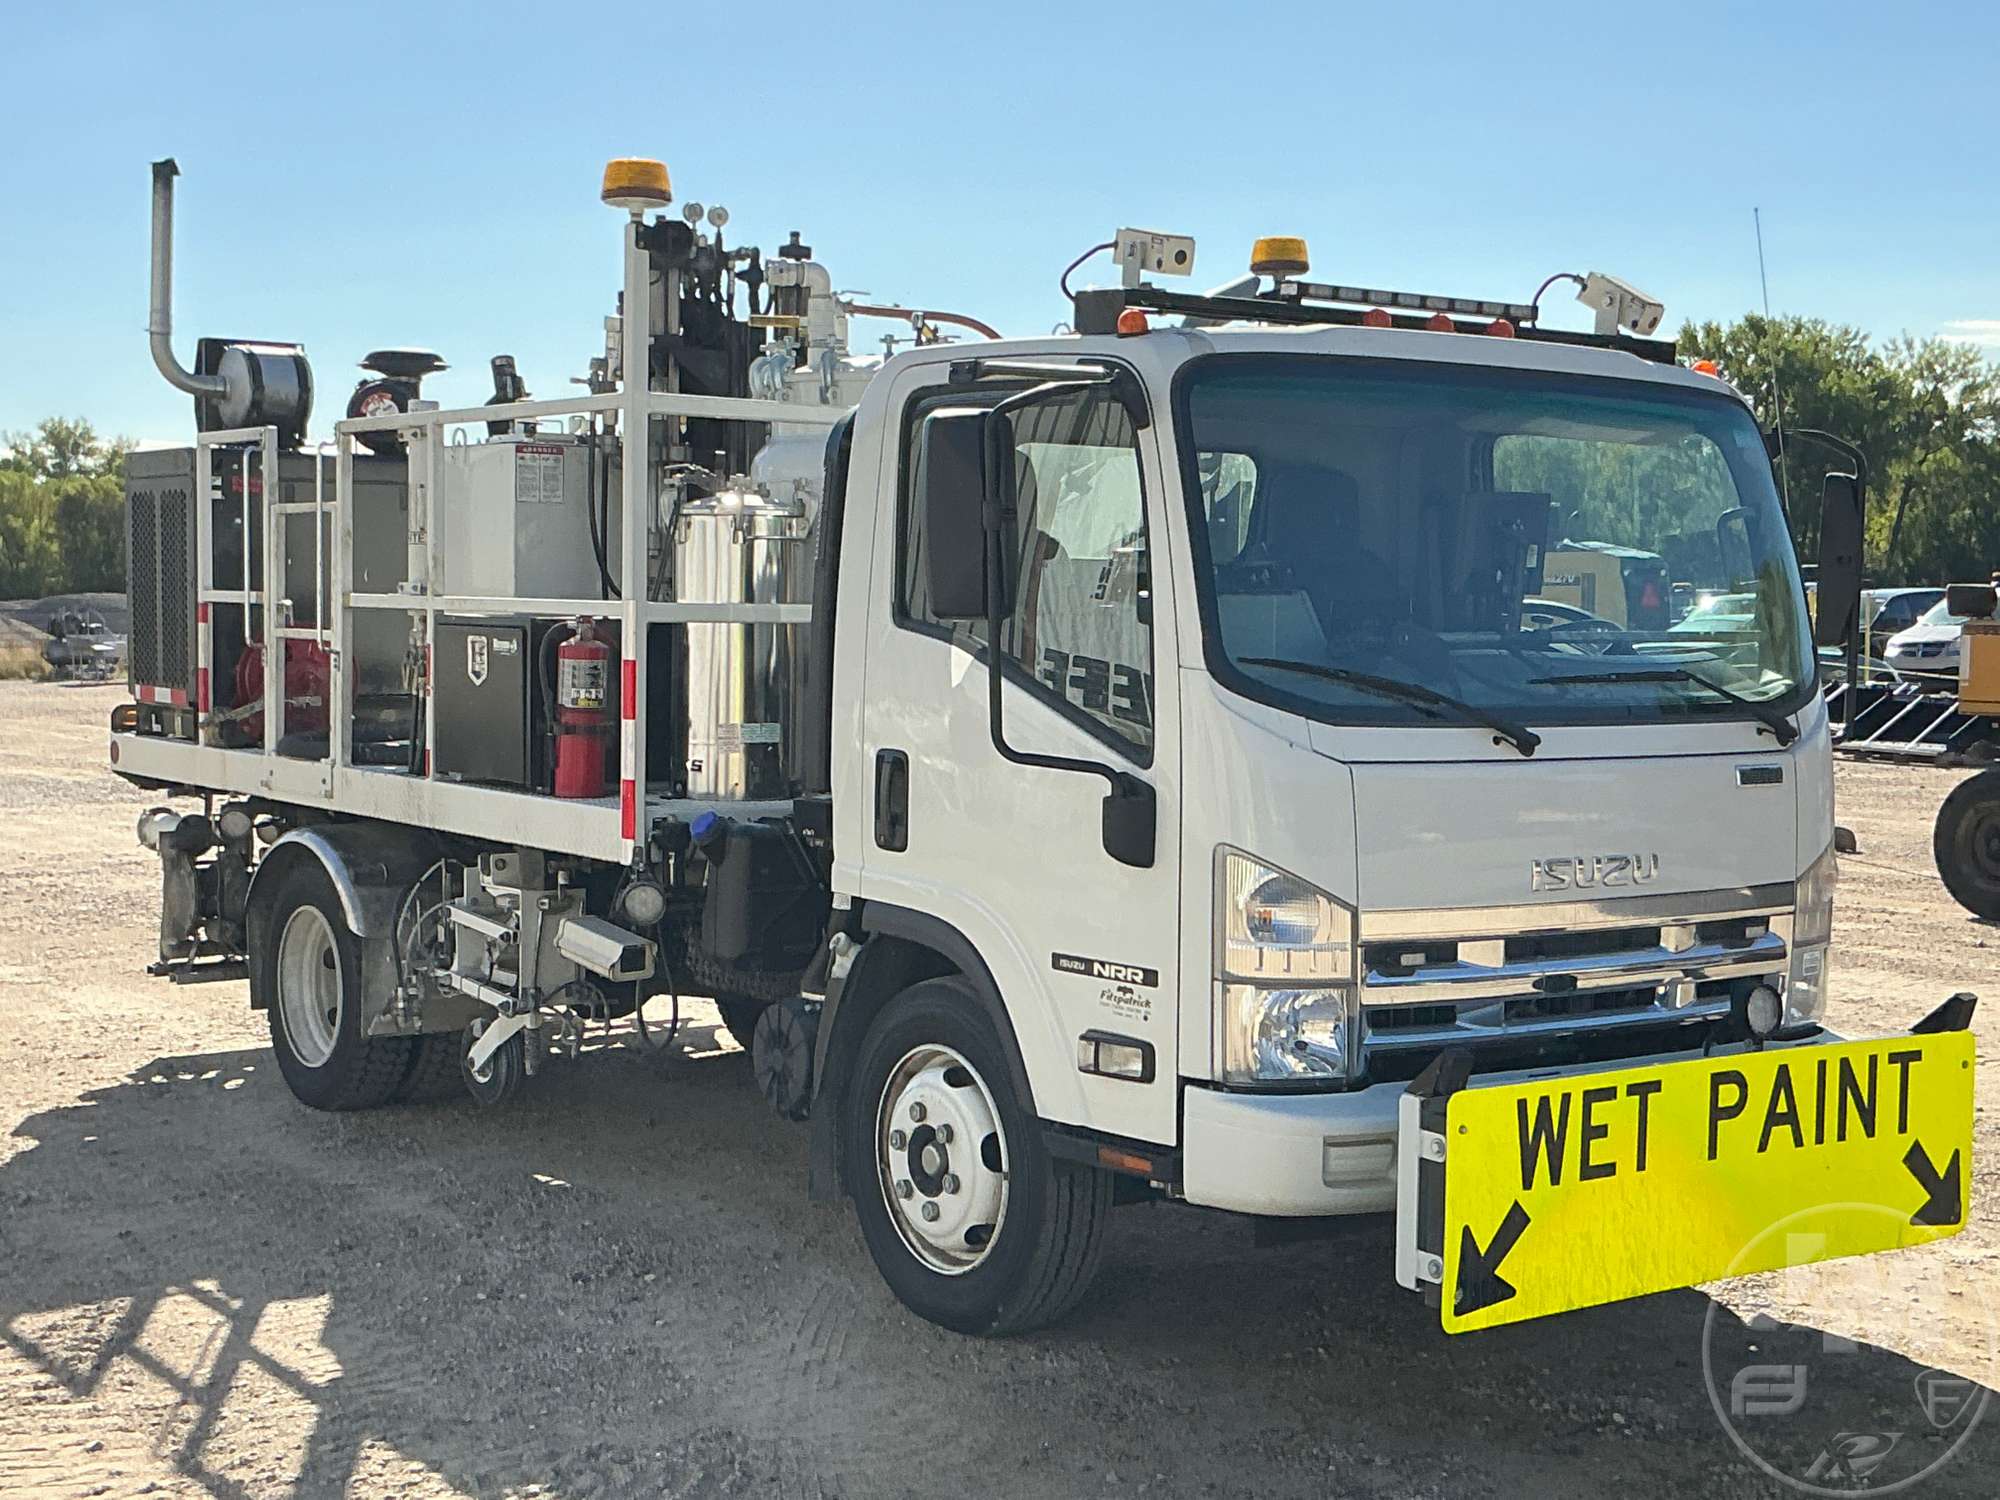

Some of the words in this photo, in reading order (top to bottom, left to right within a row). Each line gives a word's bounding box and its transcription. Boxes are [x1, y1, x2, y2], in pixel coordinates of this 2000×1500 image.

[1530, 852, 1660, 893] ISUZU
[1059, 958, 1085, 970] ISUZU
[1093, 961, 1144, 984] NRR
[1517, 1079, 1662, 1191] WET
[1707, 1049, 1923, 1161] PAINT
